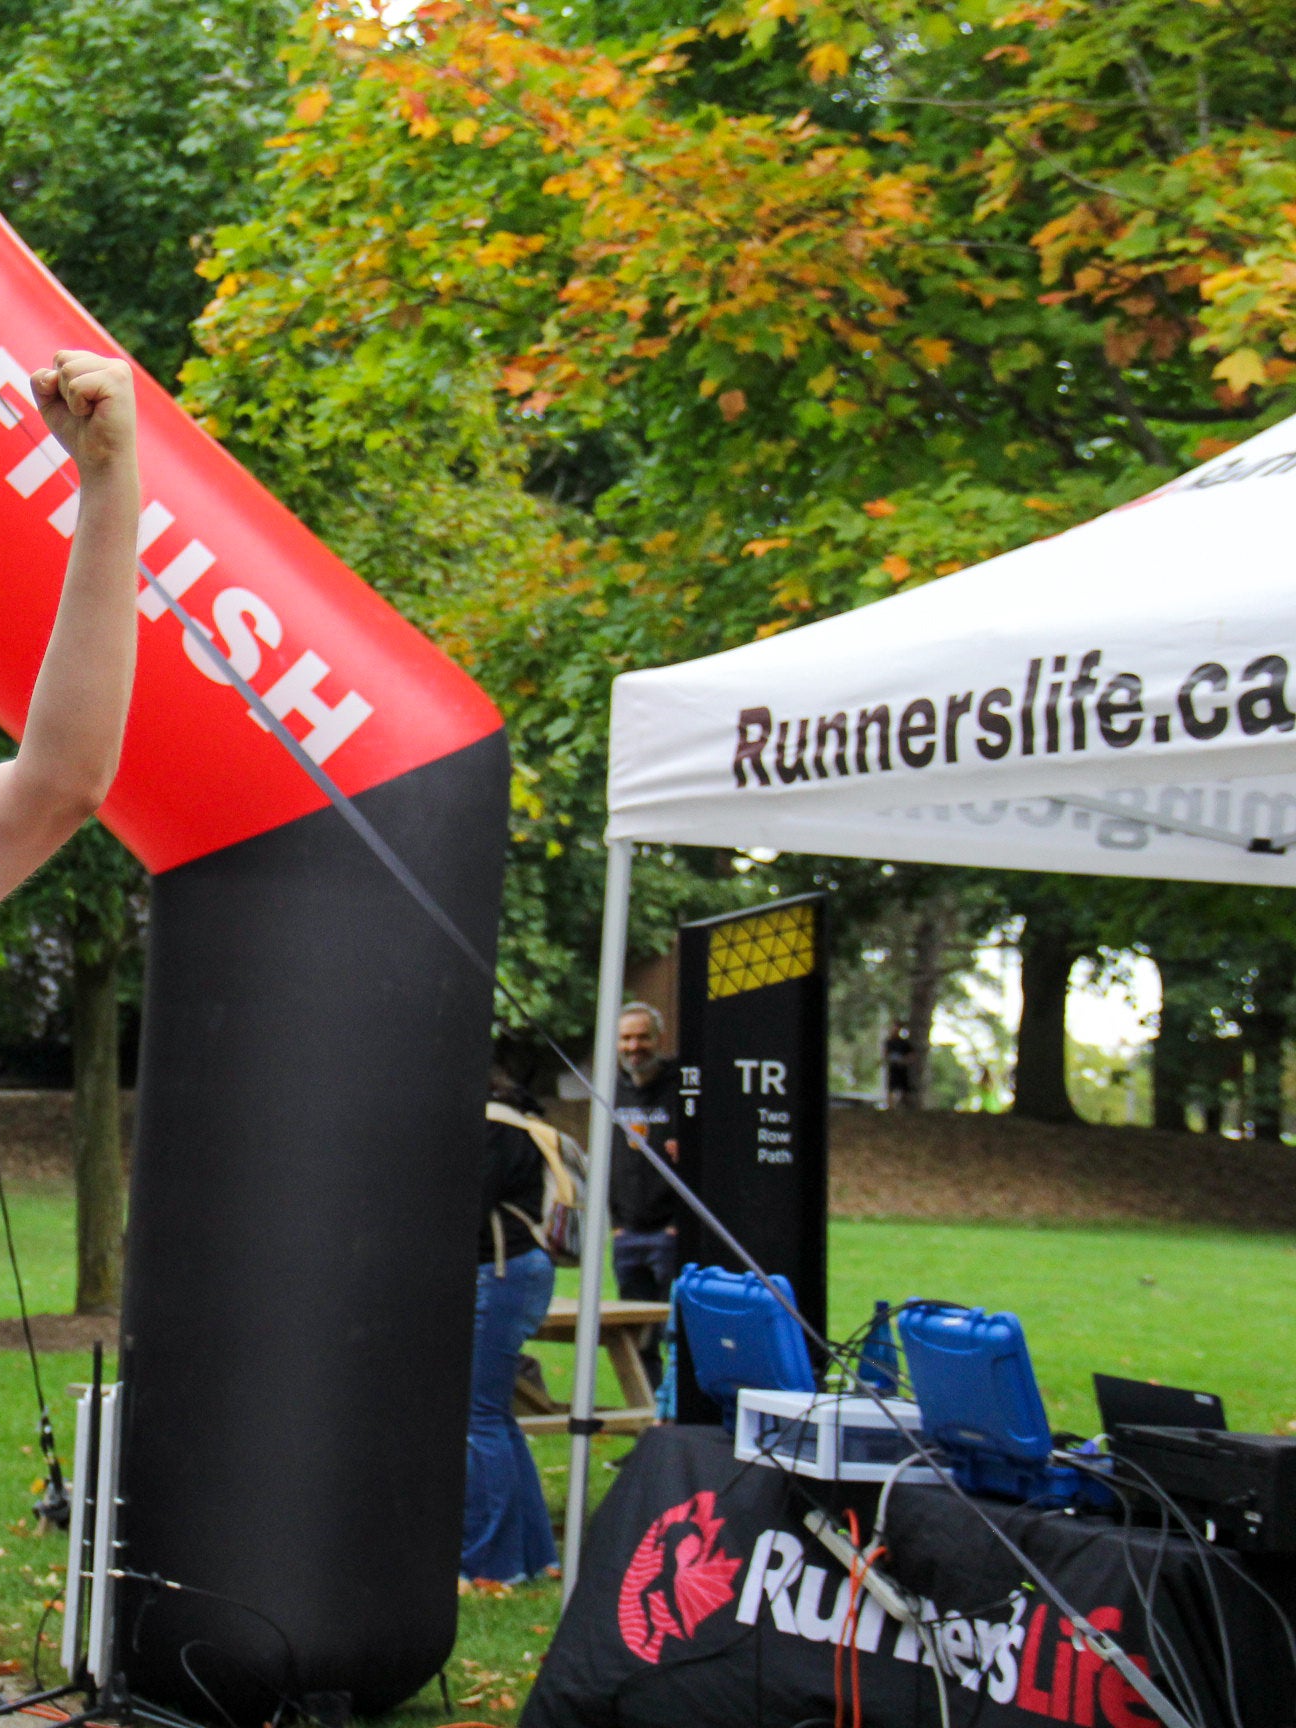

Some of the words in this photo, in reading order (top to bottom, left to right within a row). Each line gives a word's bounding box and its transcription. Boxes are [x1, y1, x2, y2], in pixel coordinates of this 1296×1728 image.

[732, 648, 1296, 788] Runnerslife.ca
[679, 1066, 701, 1087] TR
[733, 1058, 787, 1096] TR
[757, 1107, 791, 1124] Two
[757, 1127, 792, 1144] Row
[757, 1147, 794, 1165] Path
